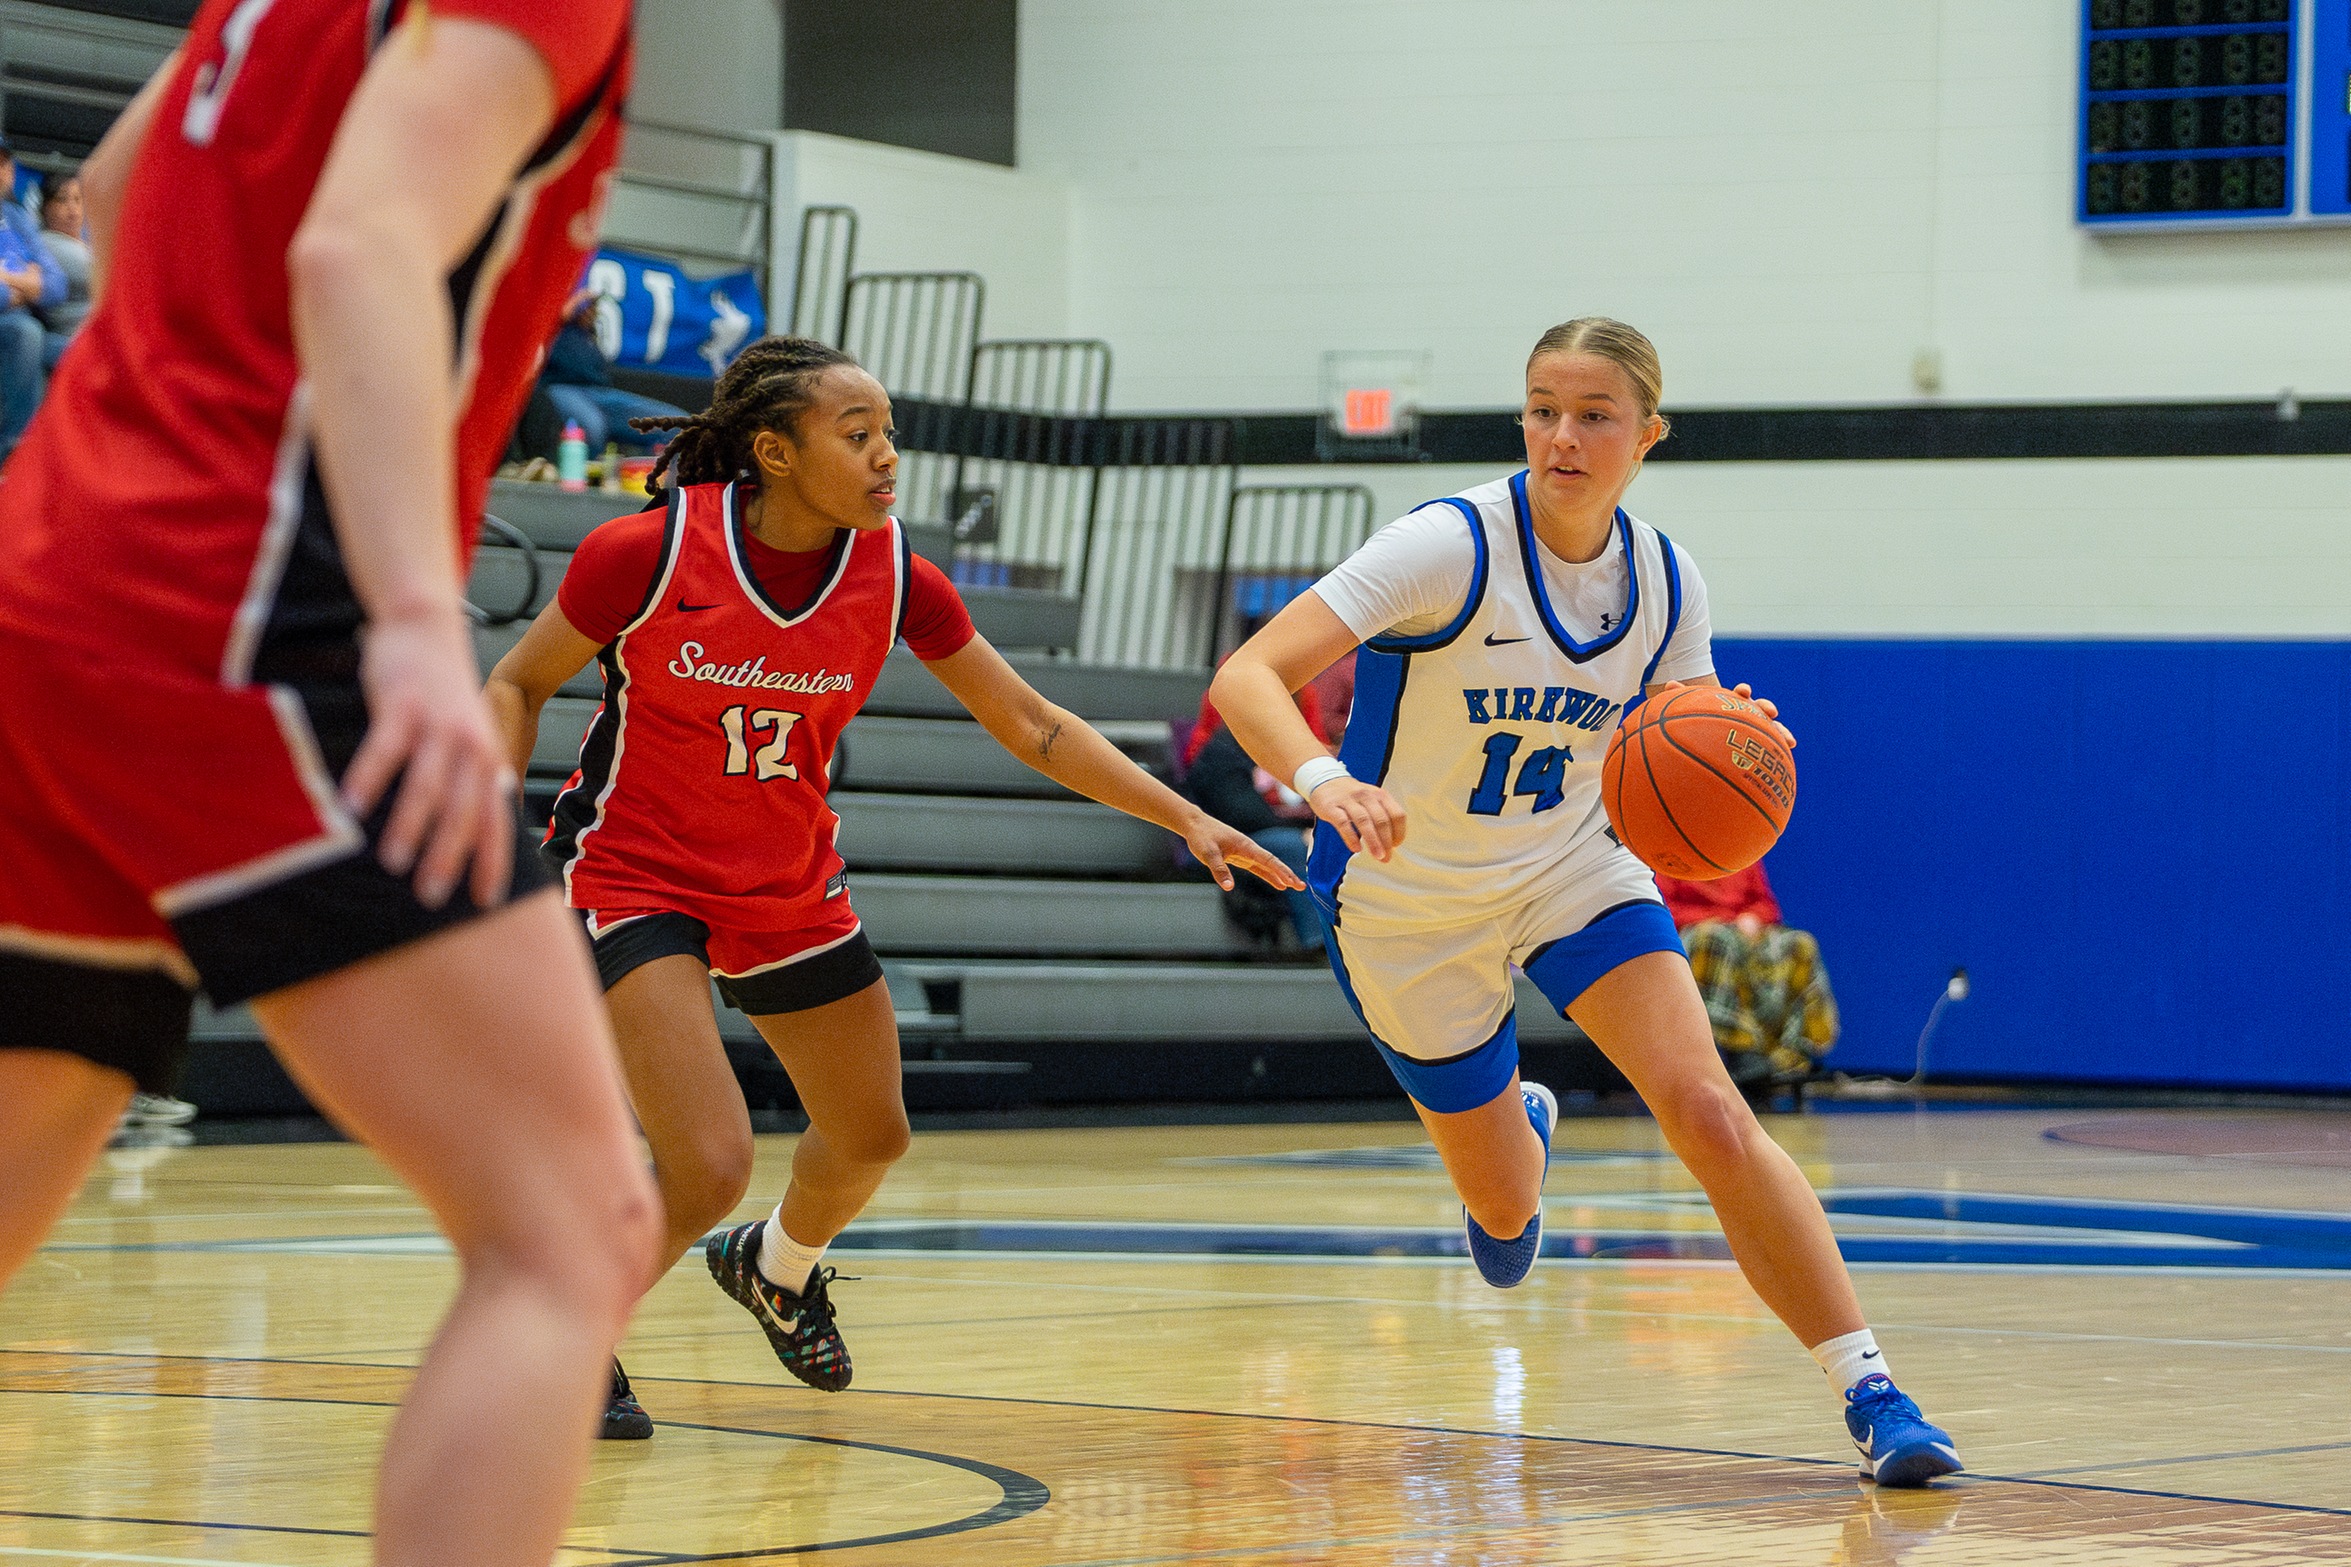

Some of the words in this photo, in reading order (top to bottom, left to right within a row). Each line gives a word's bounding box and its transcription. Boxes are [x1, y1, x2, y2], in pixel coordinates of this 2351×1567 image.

[668, 640, 854, 694] Southeastern
[718, 703, 805, 783] 12
[1466, 731, 1575, 816] 14
[1726, 728, 1795, 800] LEGACY
